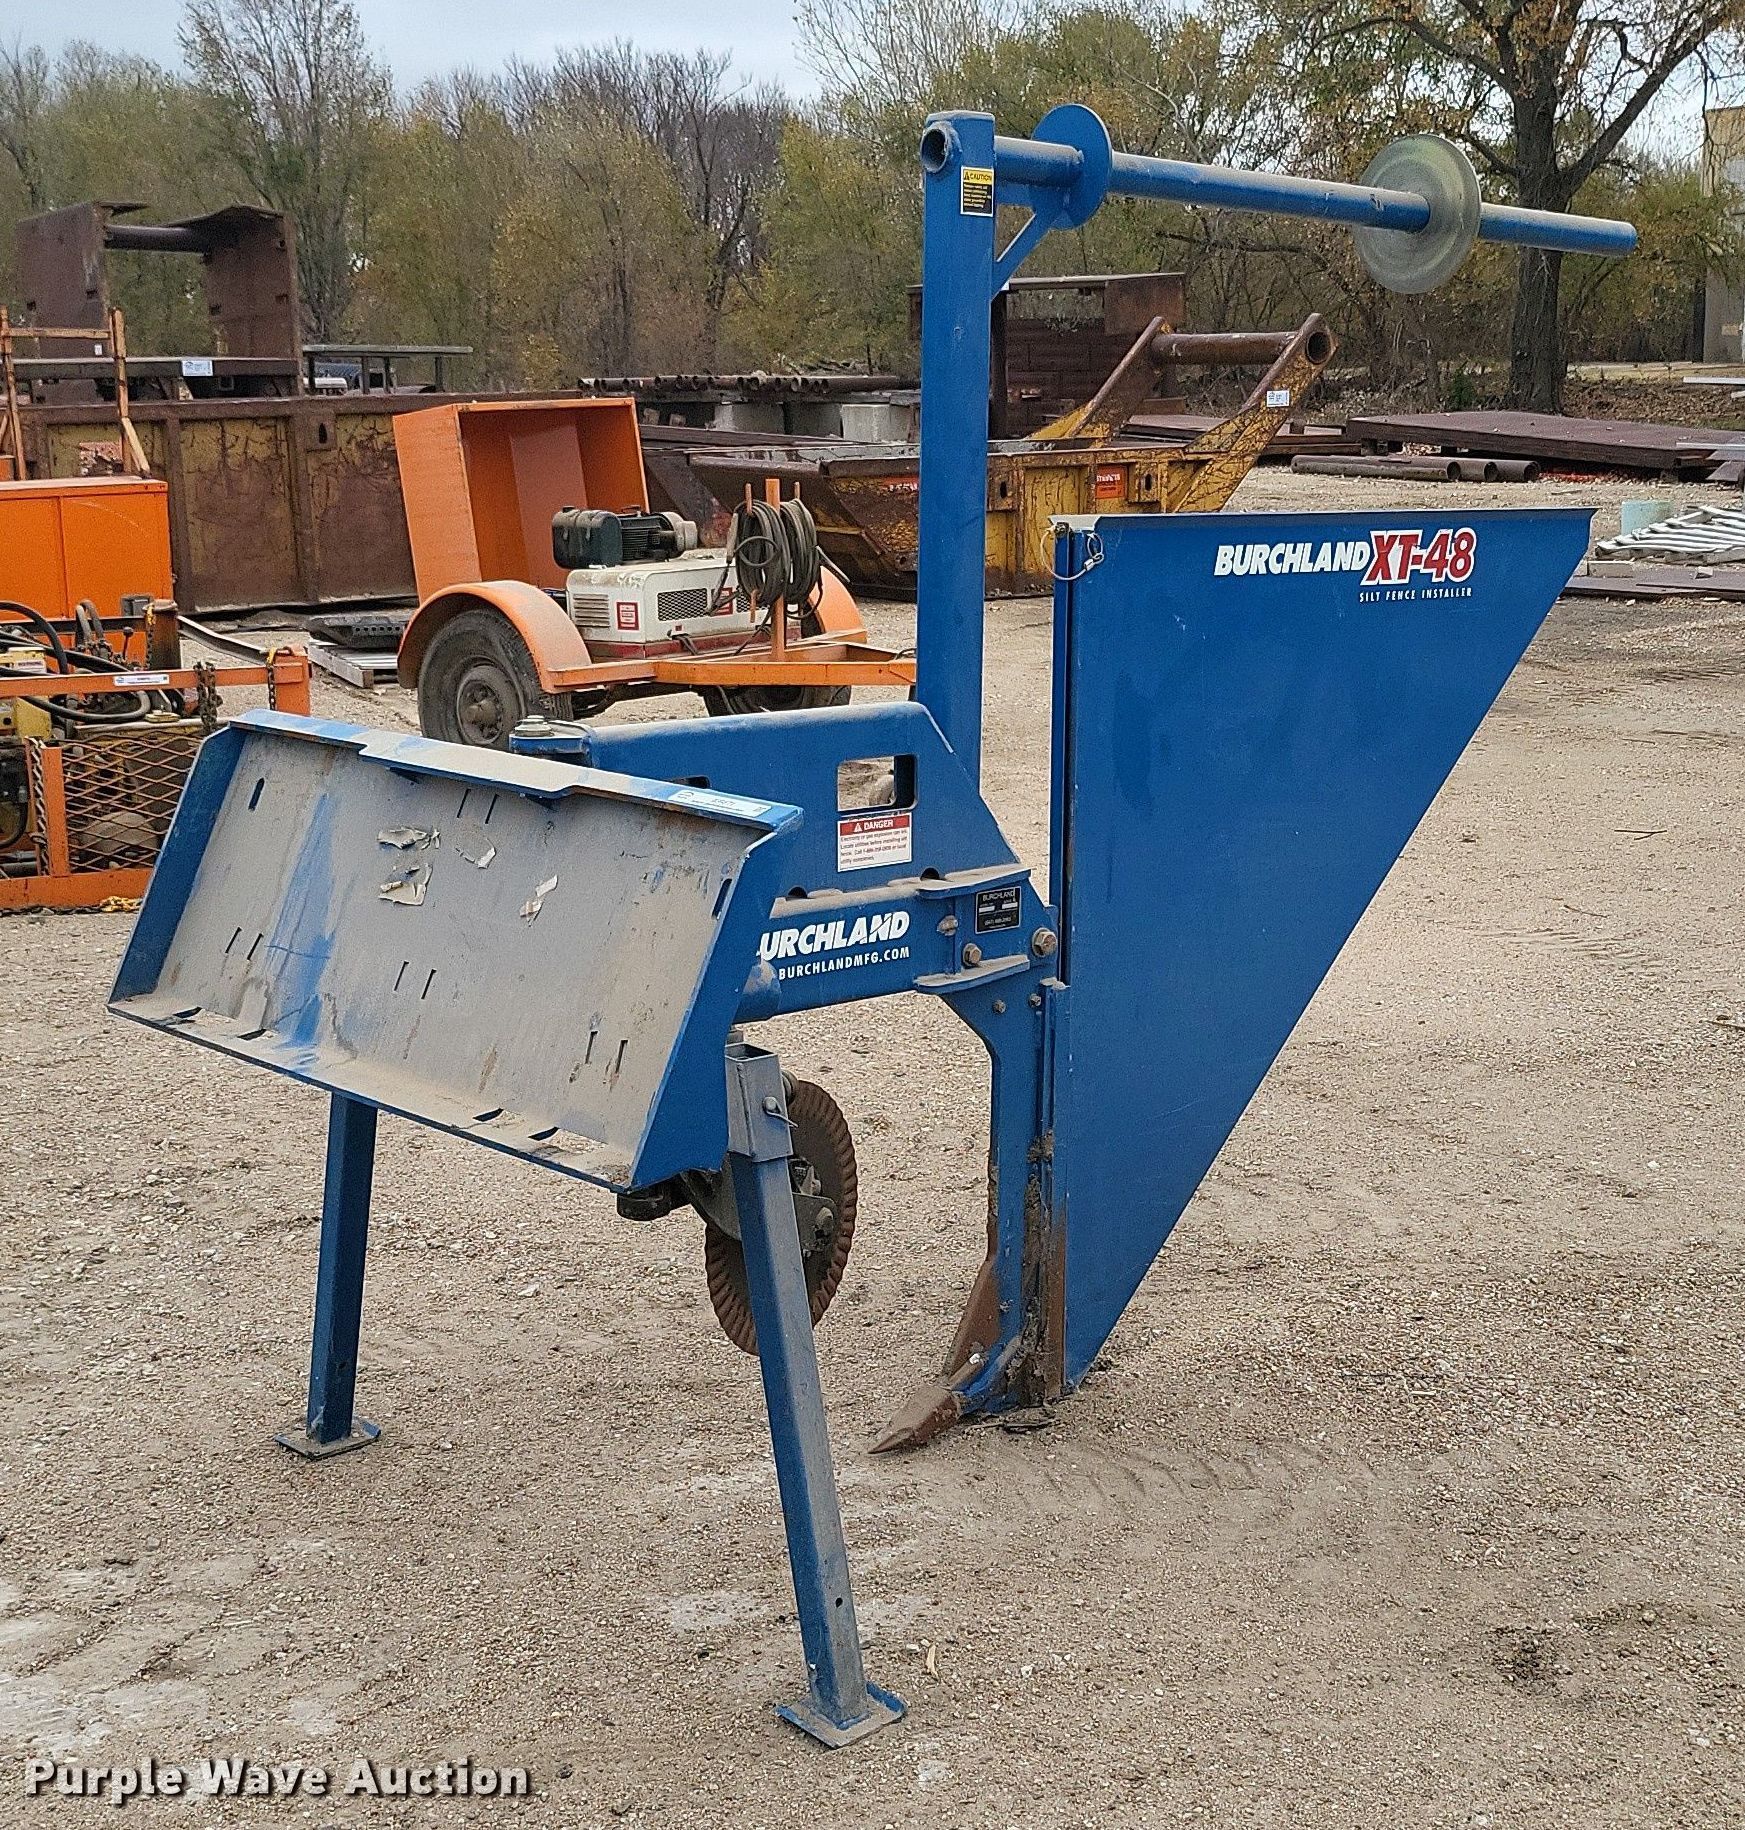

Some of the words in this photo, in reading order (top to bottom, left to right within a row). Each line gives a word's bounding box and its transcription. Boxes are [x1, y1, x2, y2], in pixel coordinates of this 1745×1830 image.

[970, 173, 992, 182] CAUTION
[1213, 541, 1371, 576] BURCHLAND
[1360, 527, 1477, 586] XT-48
[1359, 592, 1381, 602] SILT
[1386, 589, 1416, 601] FENCE
[1421, 587, 1472, 599] INSTALLER
[863, 819, 894, 831] DANGER
[983, 891, 1014, 901] BURCHLAND
[756, 911, 910, 961] URCHLAND
[778, 946, 910, 981] BURCHLANDMFG.COM
